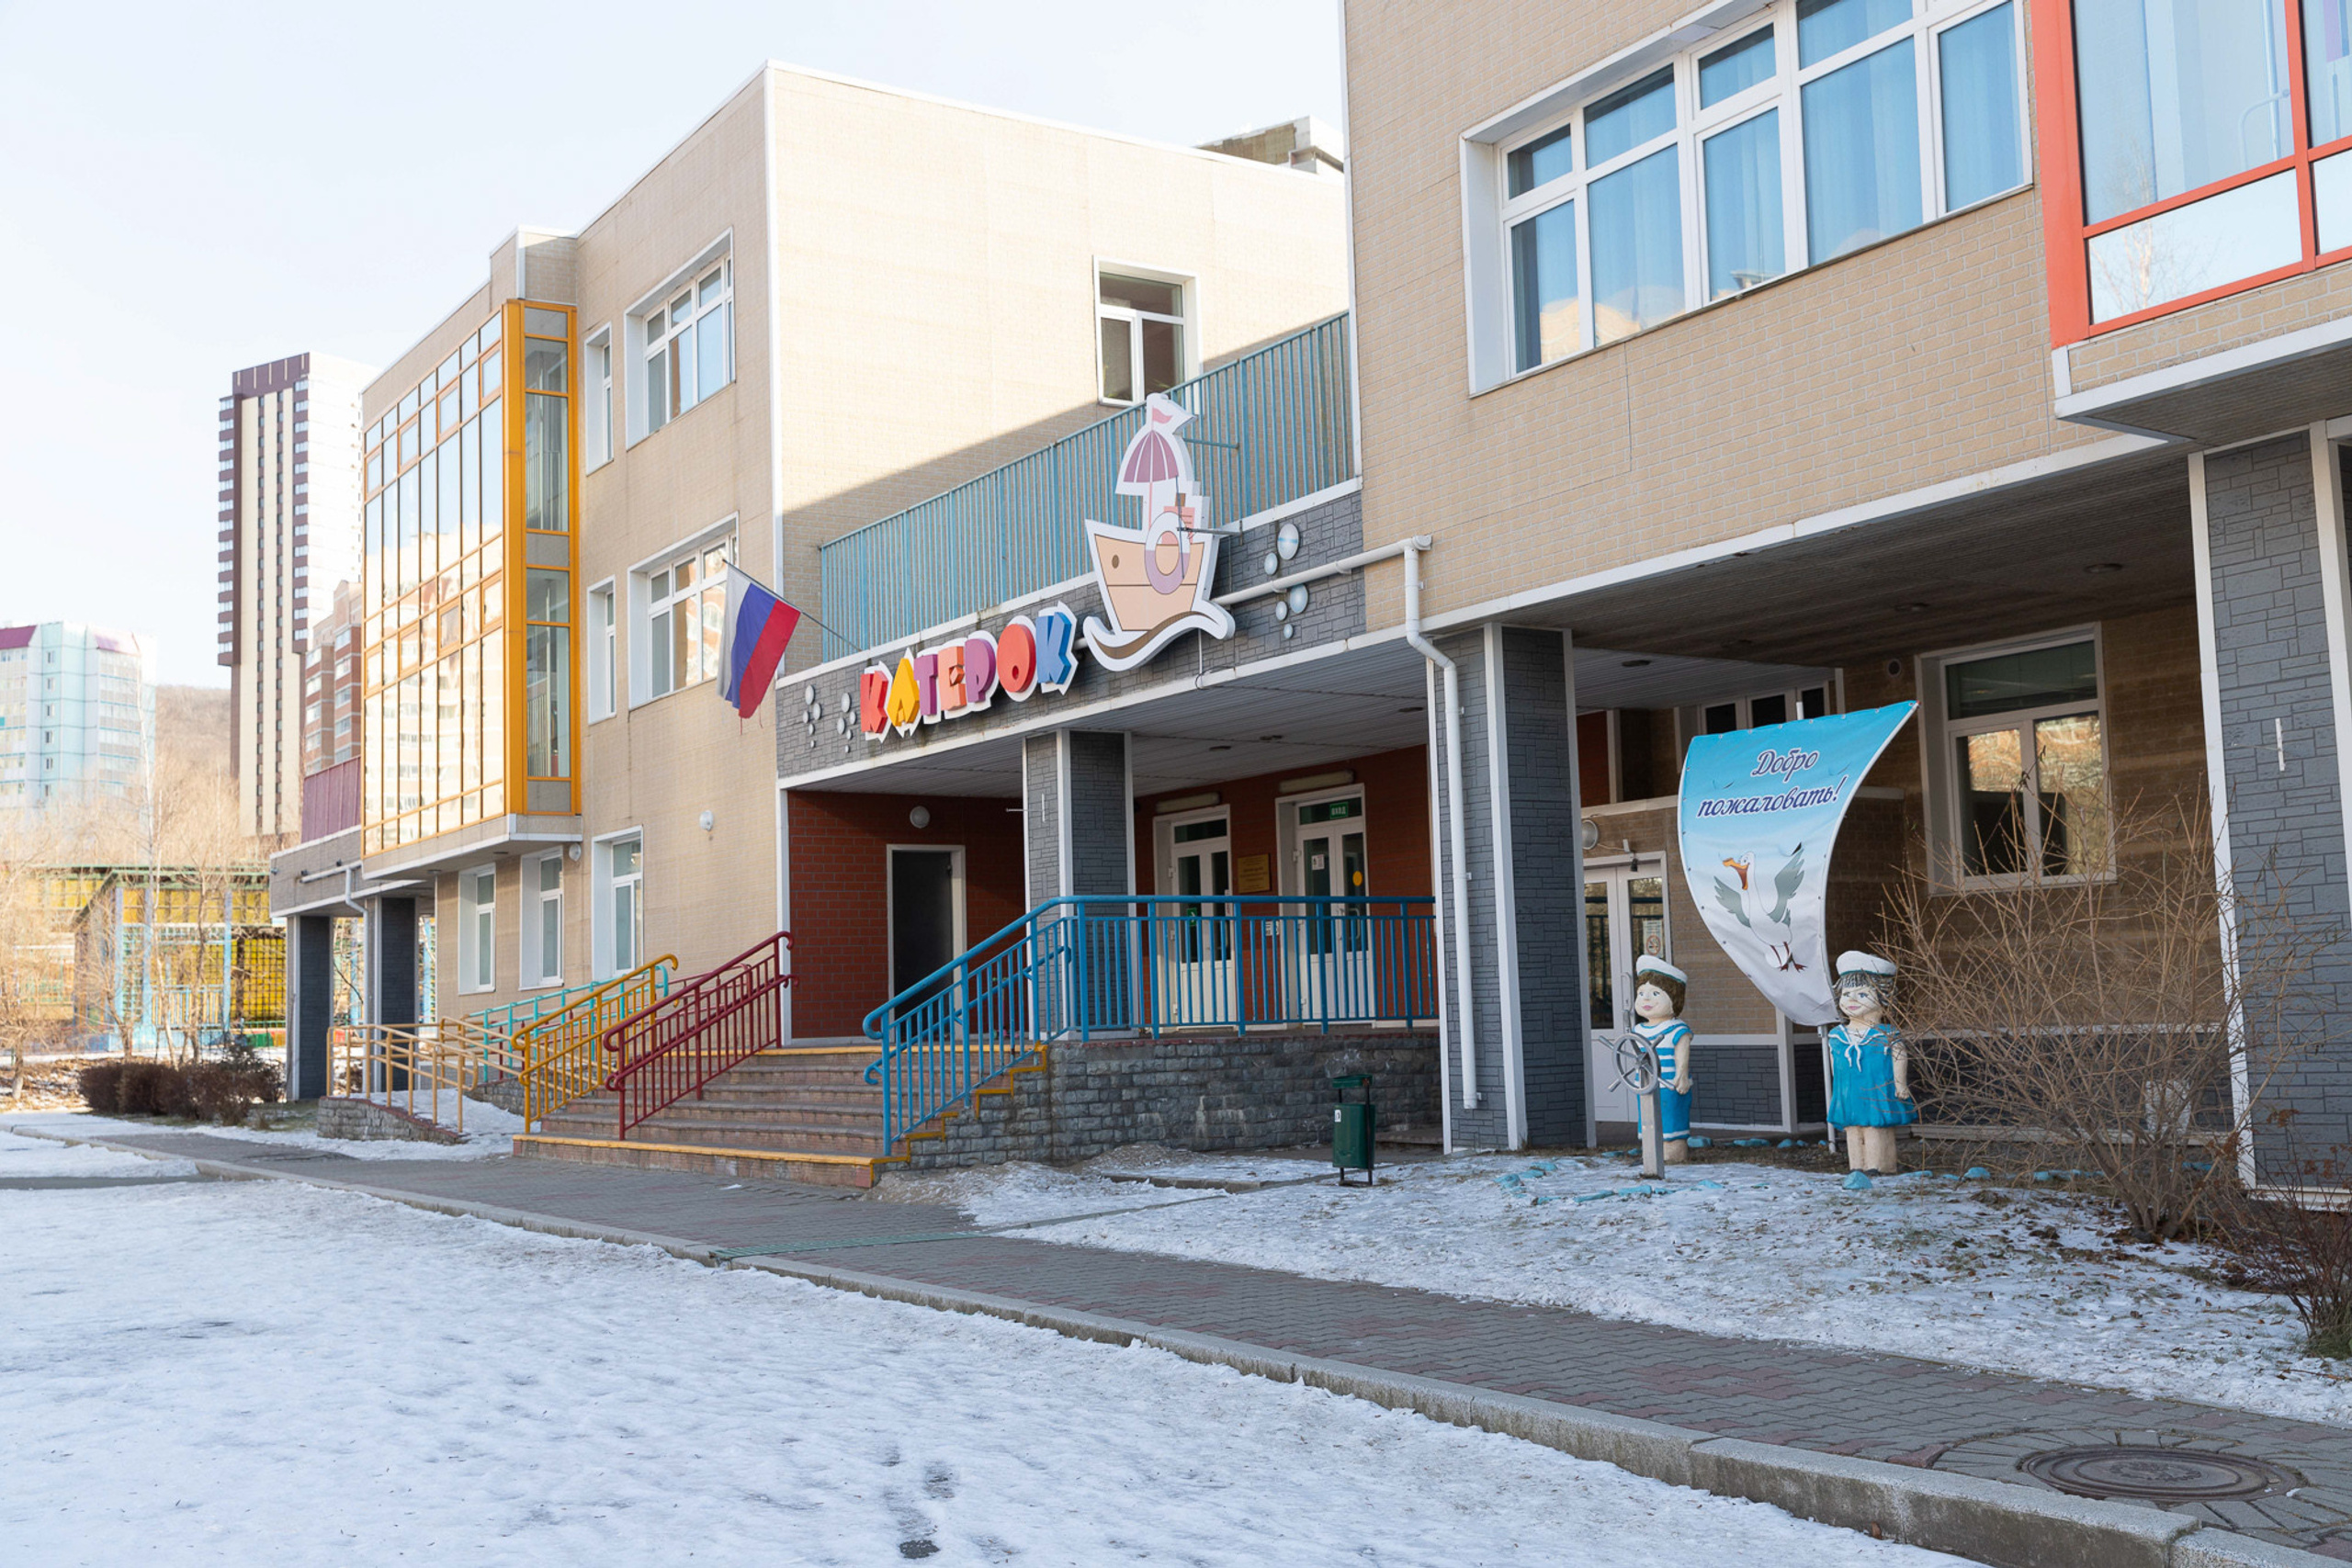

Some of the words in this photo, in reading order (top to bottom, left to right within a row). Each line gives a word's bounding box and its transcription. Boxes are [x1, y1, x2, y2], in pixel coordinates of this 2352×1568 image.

[859, 609, 1073, 736] КАТЕРОК
[1751, 748, 1819, 782] Добро
[1697, 775, 1849, 818] пожаловать!
